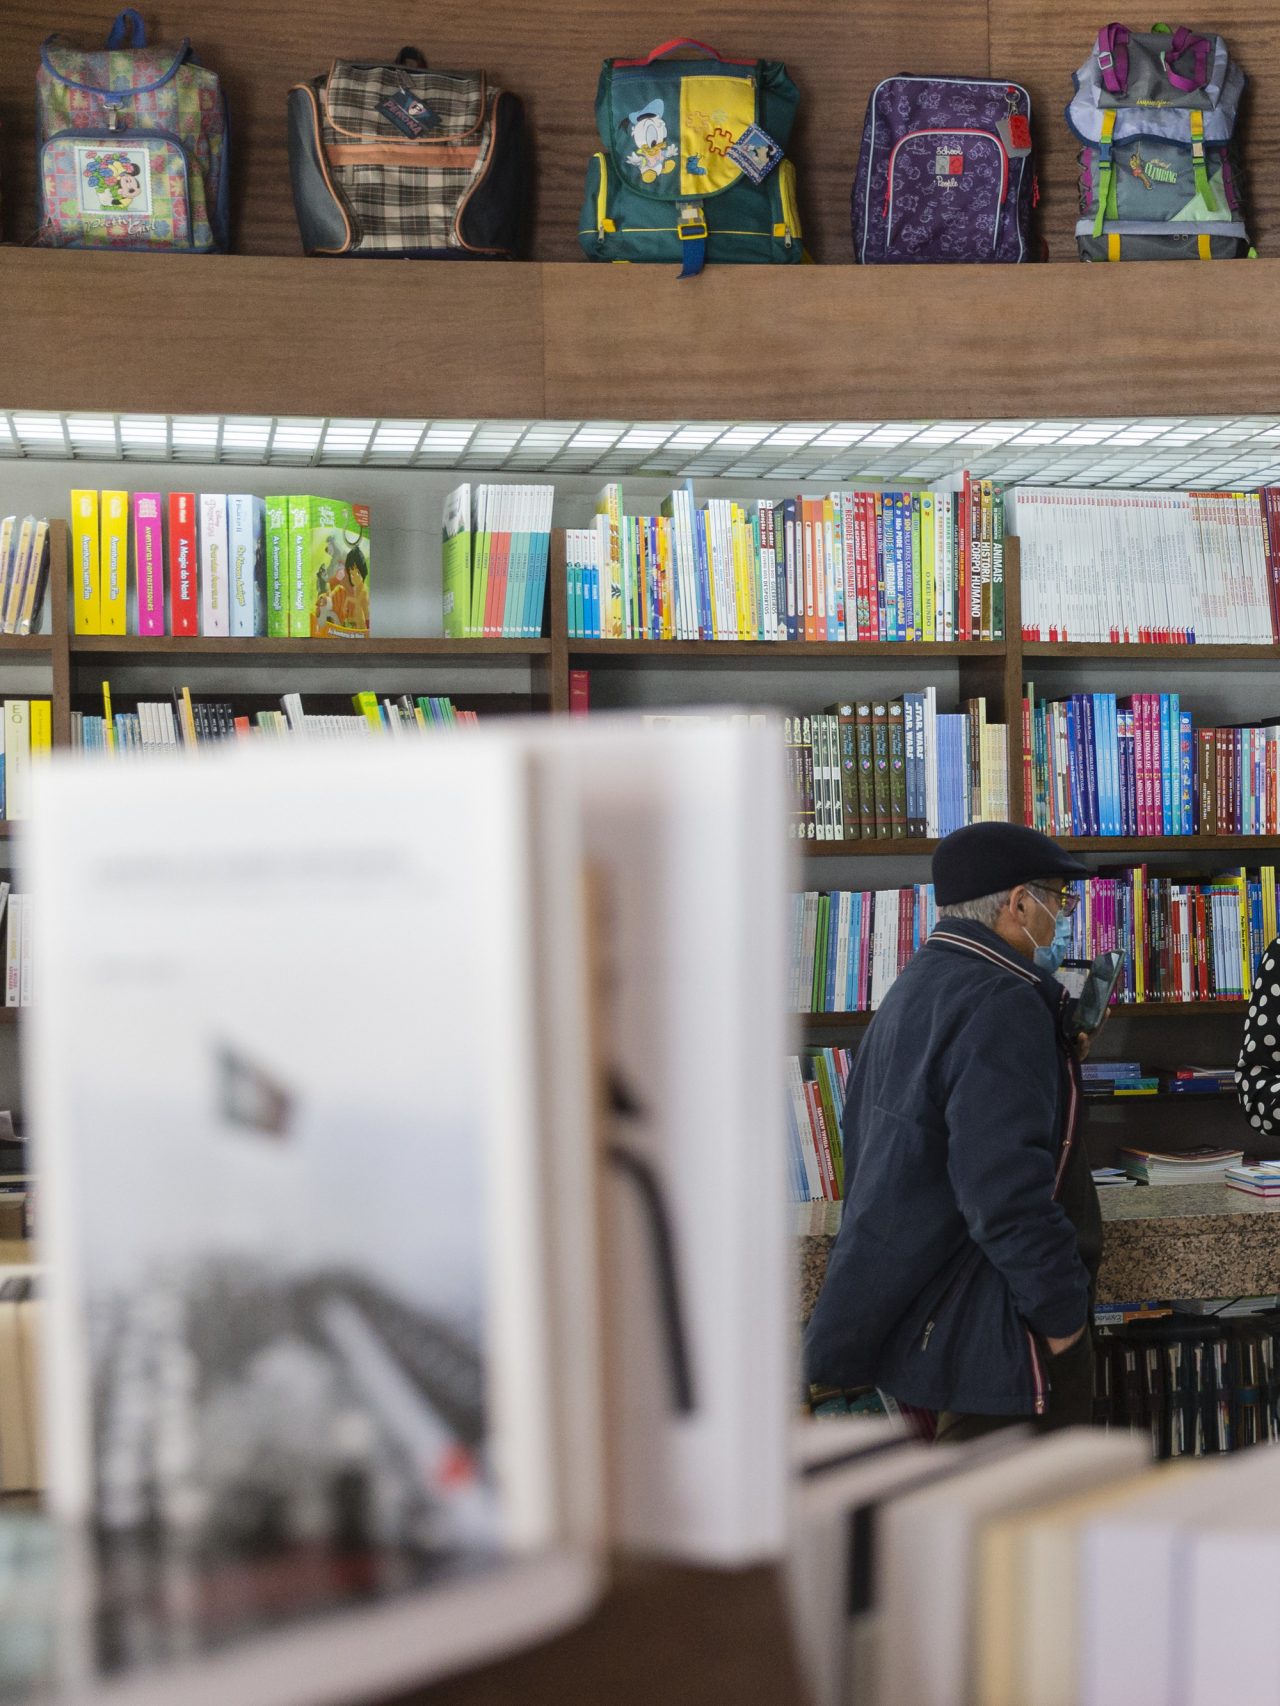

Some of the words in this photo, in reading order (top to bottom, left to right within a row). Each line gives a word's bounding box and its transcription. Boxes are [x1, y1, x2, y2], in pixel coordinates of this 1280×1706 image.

[845, 509, 853, 540] RECORDES
[846, 543, 854, 600] IMPRESSIONANTES!
[971, 541, 981, 572] CORPO
[993, 543, 1002, 583] ANIMAIS
[887, 563, 896, 596] VERDADE!
[971, 575, 981, 617] HUMANO
[915, 702, 923, 730] STAR
